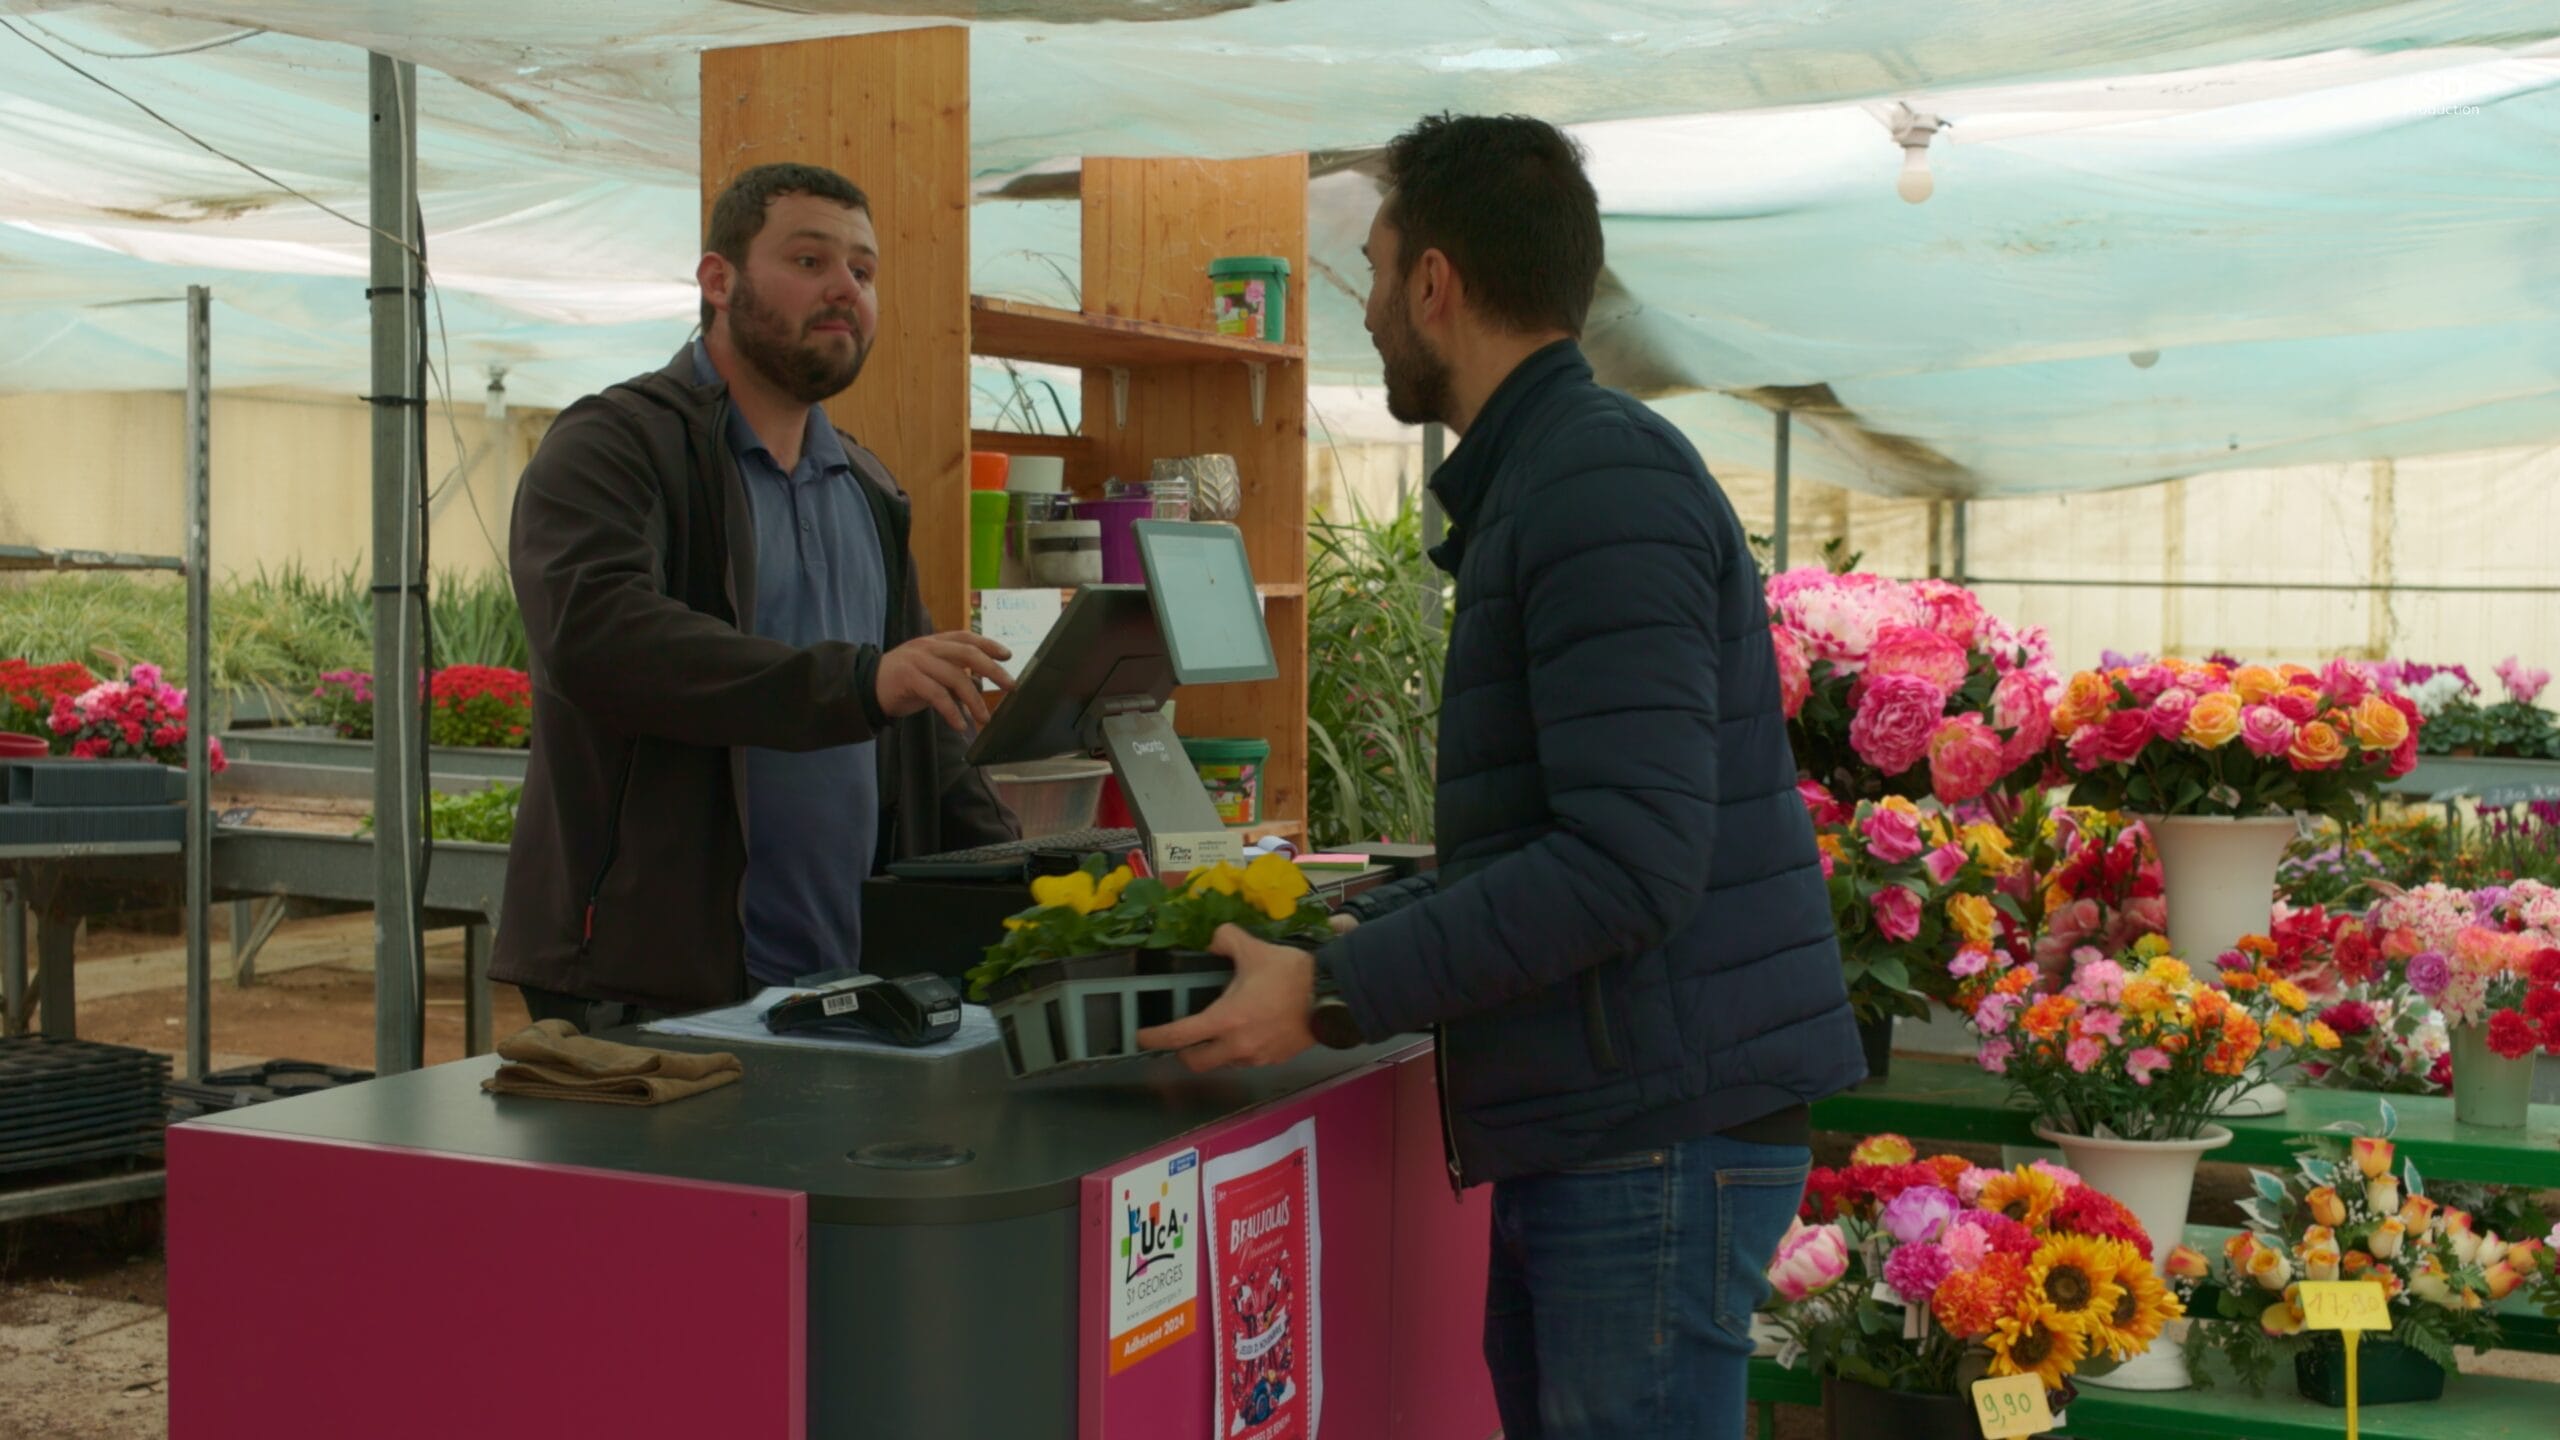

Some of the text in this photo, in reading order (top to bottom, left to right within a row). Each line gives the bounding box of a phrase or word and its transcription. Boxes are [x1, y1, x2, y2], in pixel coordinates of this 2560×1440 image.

[1231, 1196, 1290, 1253] BEAUJOLAIS
[1137, 1263, 1184, 1301] GEORGES
[1163, 1312, 1185, 1335] 2024
[1982, 1392, 2032, 1428] 9,90
